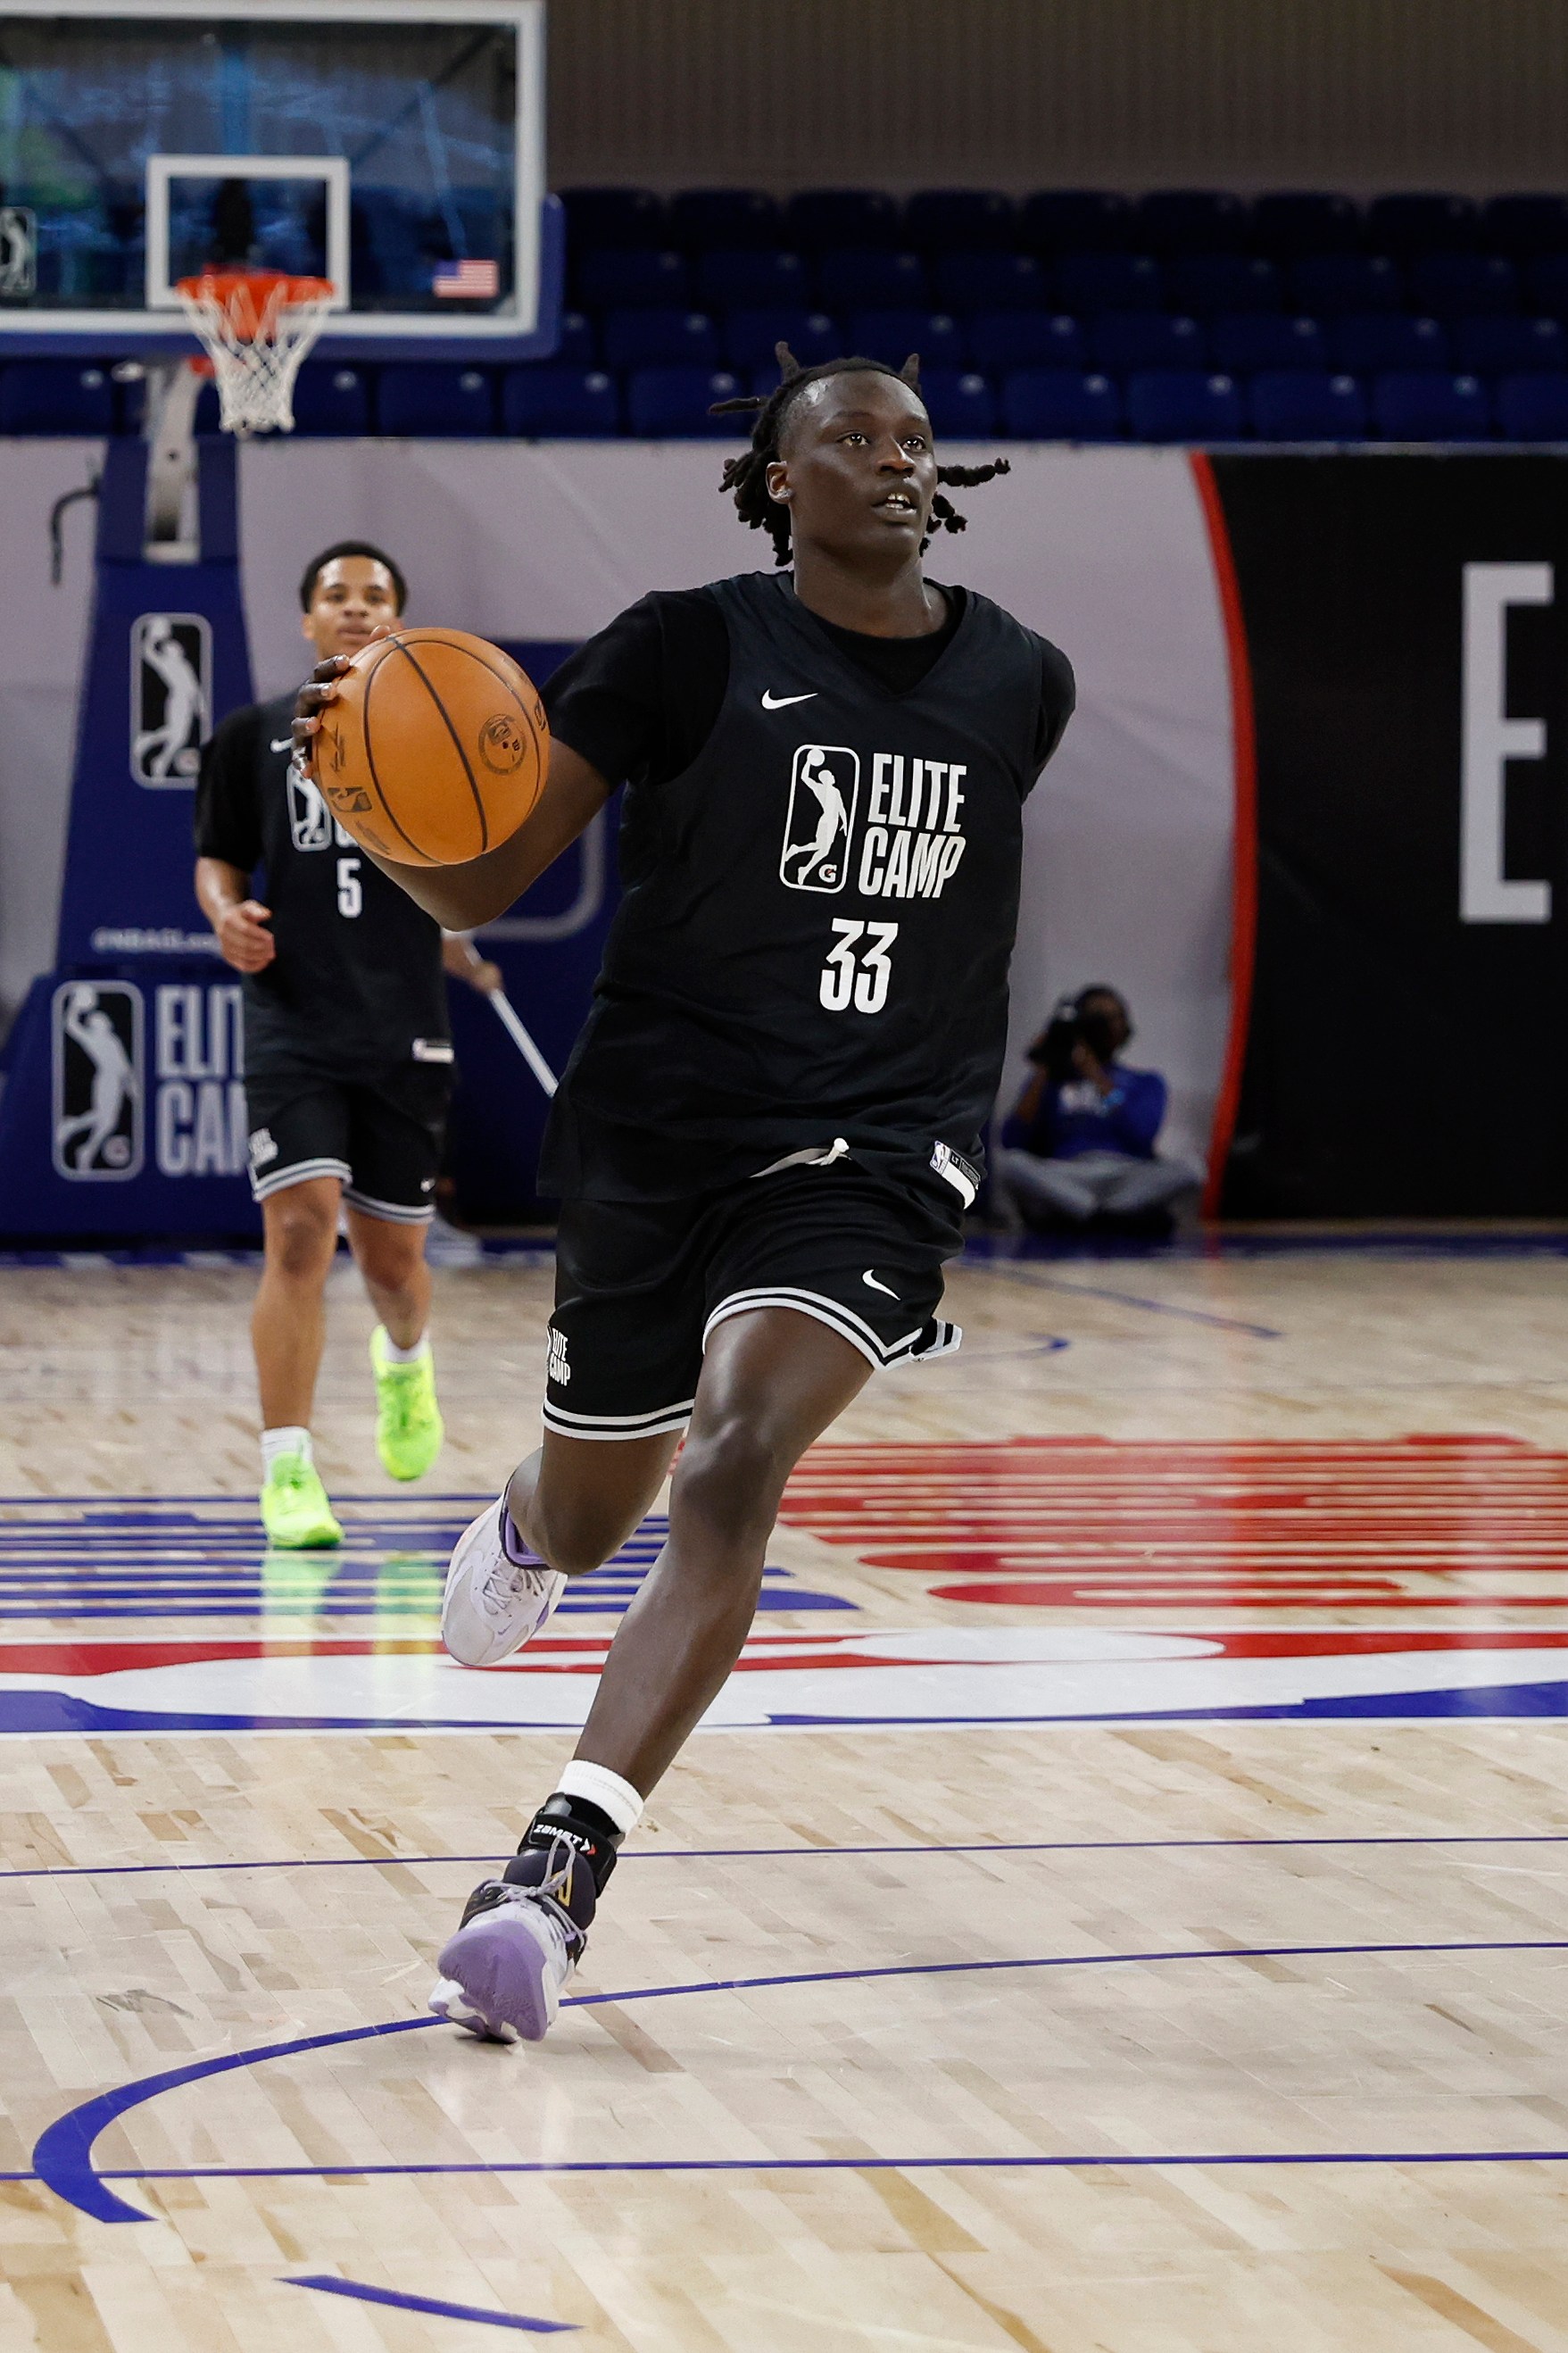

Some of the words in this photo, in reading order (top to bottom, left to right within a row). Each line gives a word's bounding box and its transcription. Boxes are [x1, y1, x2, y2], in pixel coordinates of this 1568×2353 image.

[867, 752, 967, 832] ELITE
[336, 858, 362, 919] 5
[859, 827, 966, 898] CAMP
[819, 918, 898, 1014] 33
